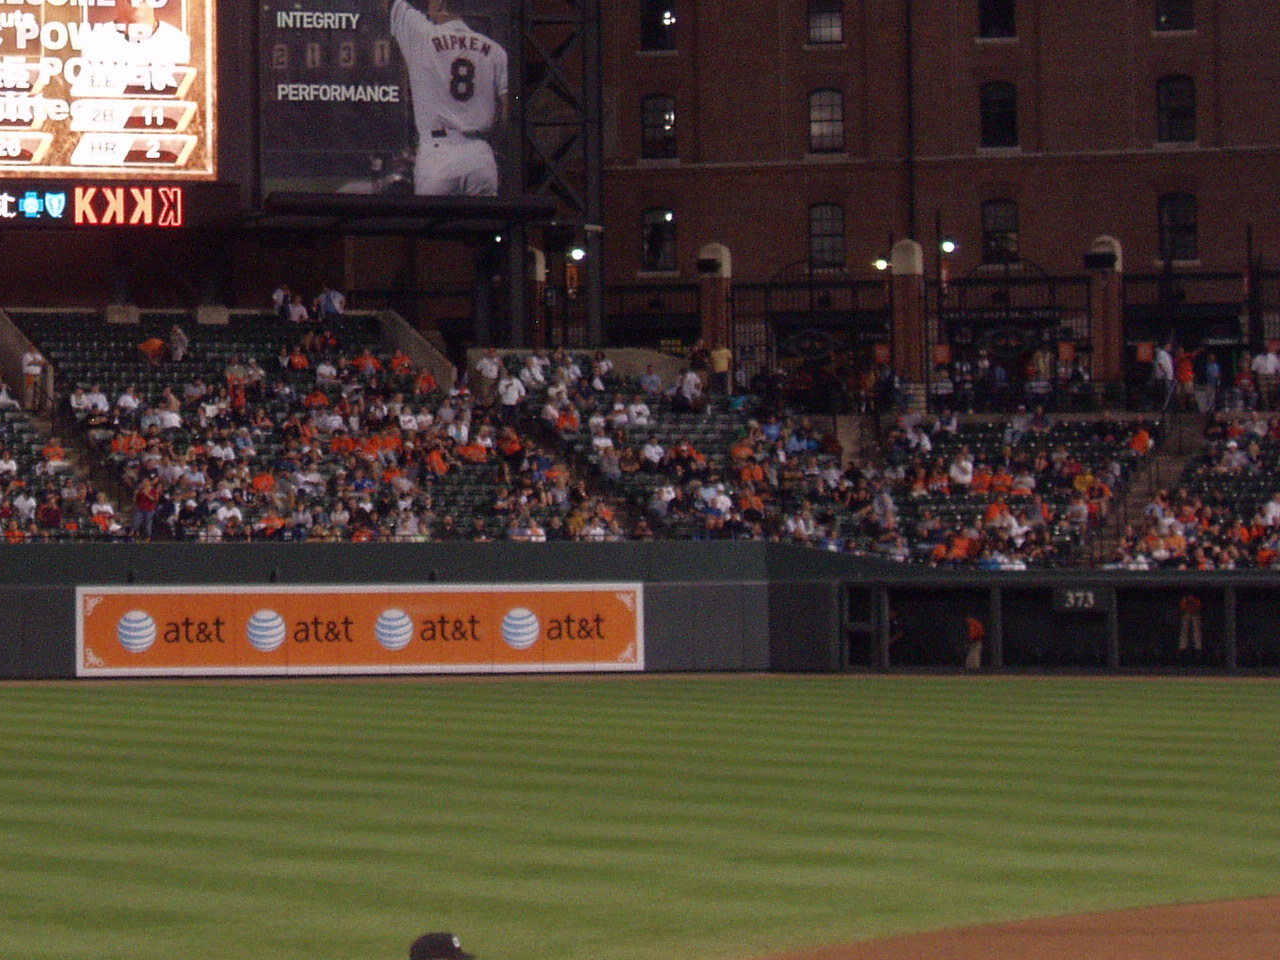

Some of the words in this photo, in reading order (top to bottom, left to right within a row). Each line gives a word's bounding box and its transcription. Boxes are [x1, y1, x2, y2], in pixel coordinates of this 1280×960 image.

[276, 11, 360, 30] INTEGRITY
[16, 21, 153, 51] POWER
[431, 35, 491, 57] RIPKEN
[450, 57, 476, 102] 8
[277, 84, 400, 103] PERFORMANCE
[92, 108, 115, 122] 2B
[141, 106, 164, 126] 11
[91, 142, 117, 155] HR
[145, 139, 161, 158] 2
[1065, 591, 1095, 608] 373
[163, 615, 226, 644] at&t
[293, 615, 354, 644] at&t
[420, 613, 481, 642] at&t
[546, 612, 606, 641] at&t
